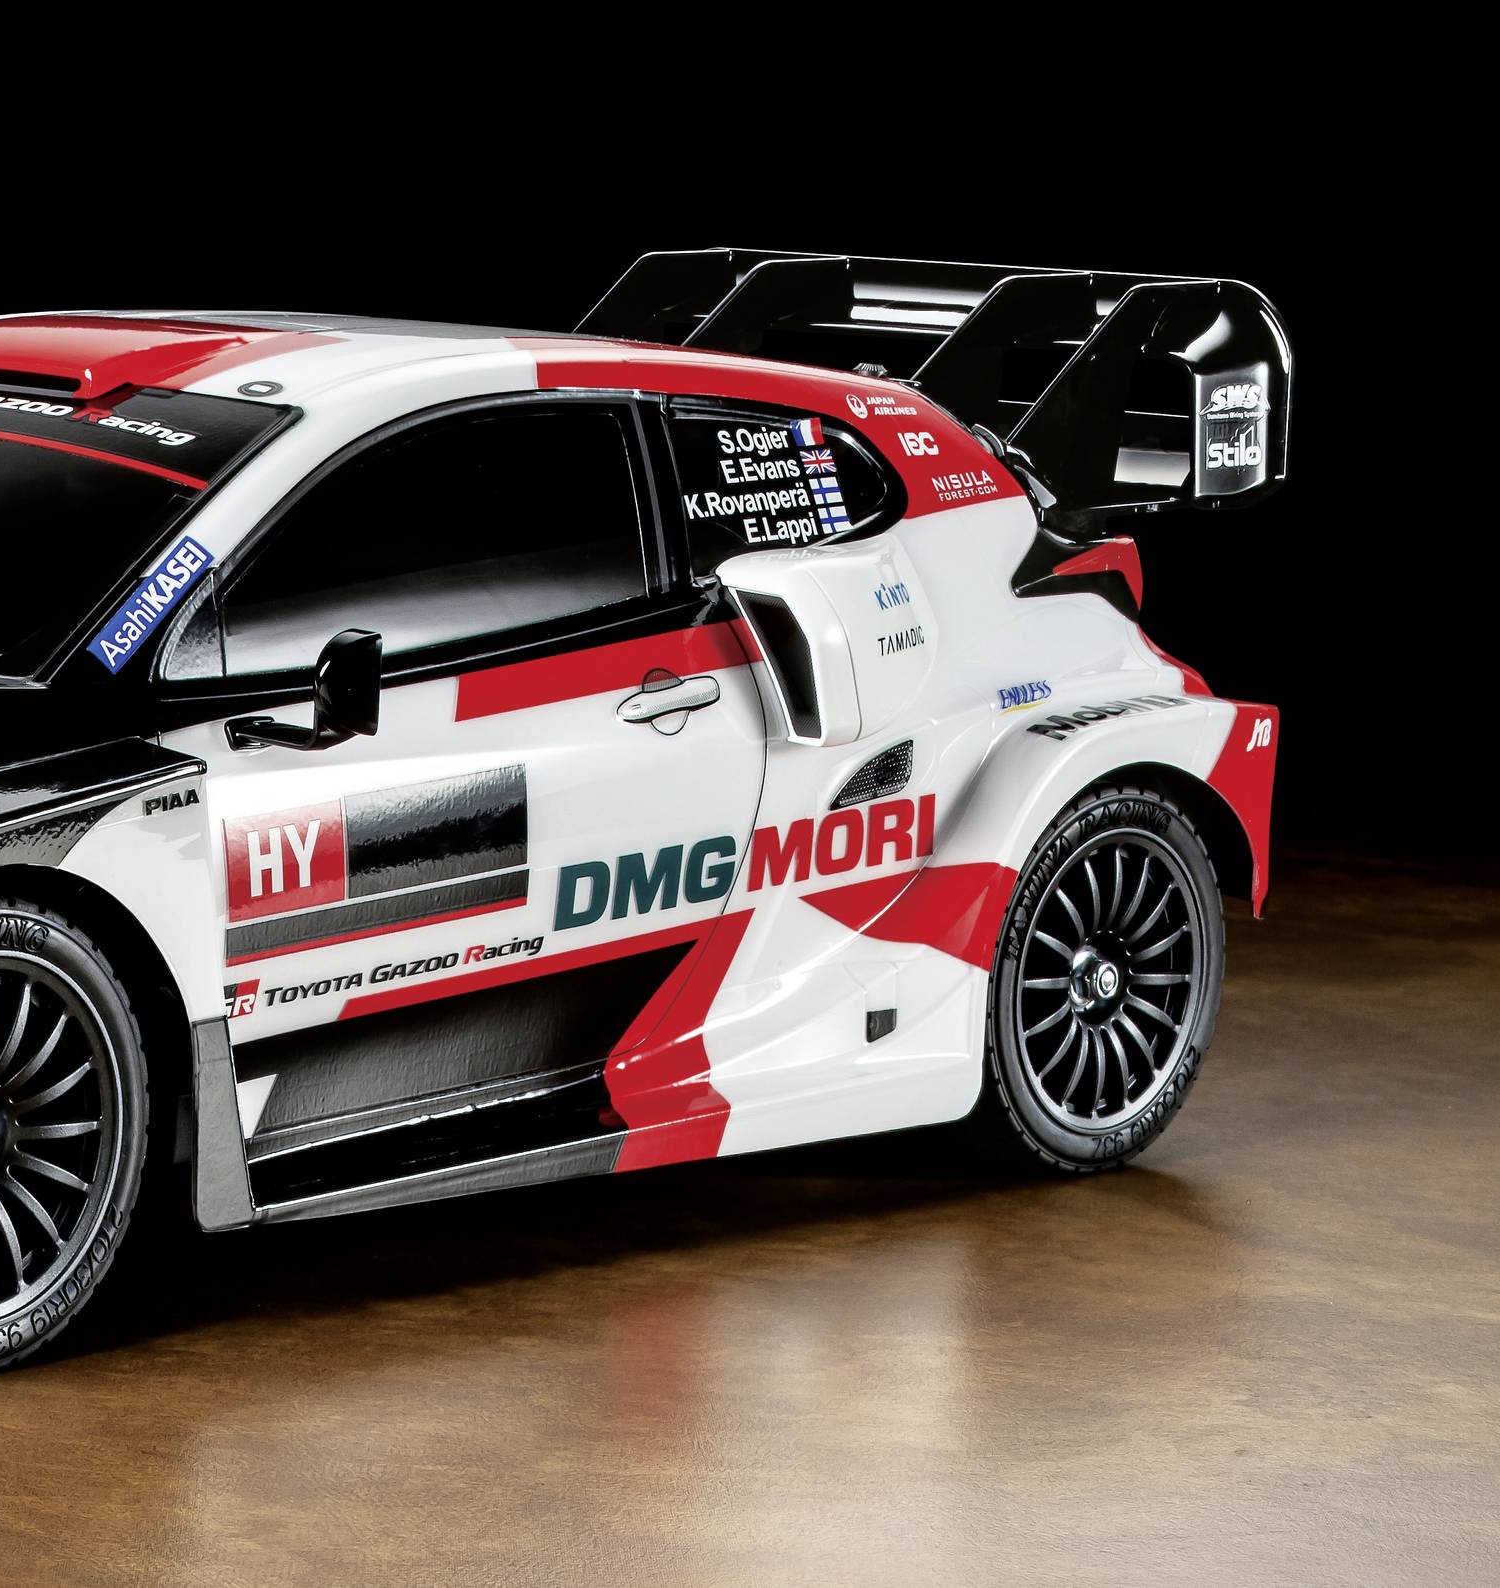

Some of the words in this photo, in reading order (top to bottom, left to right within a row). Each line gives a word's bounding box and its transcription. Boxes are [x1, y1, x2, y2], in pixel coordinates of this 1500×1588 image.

[866, 397, 895, 406] JAPAN
[874, 407, 917, 416] AIRLINES
[1206, 384, 1262, 412] SWS
[69, 407, 196, 446] Racing
[717, 427, 789, 456] S.Ogier
[1208, 433, 1262, 468] Stilo
[720, 457, 800, 484] E.Evans
[932, 470, 993, 492] NISULA
[684, 482, 811, 519] K.Rovanperä
[743, 512, 818, 544] E.Lappi
[878, 626, 925, 656] TAMADIC
[998, 680, 1052, 709] ENDLESS
[143, 788, 200, 816] PIAA
[247, 819, 323, 899] HY
[553, 835, 738, 932] DMG
[746, 794, 937, 893] MORI
[265, 973, 363, 1007] TOYOTA
[369, 950, 460, 984] GAZOO
[462, 935, 543, 966] Racing
